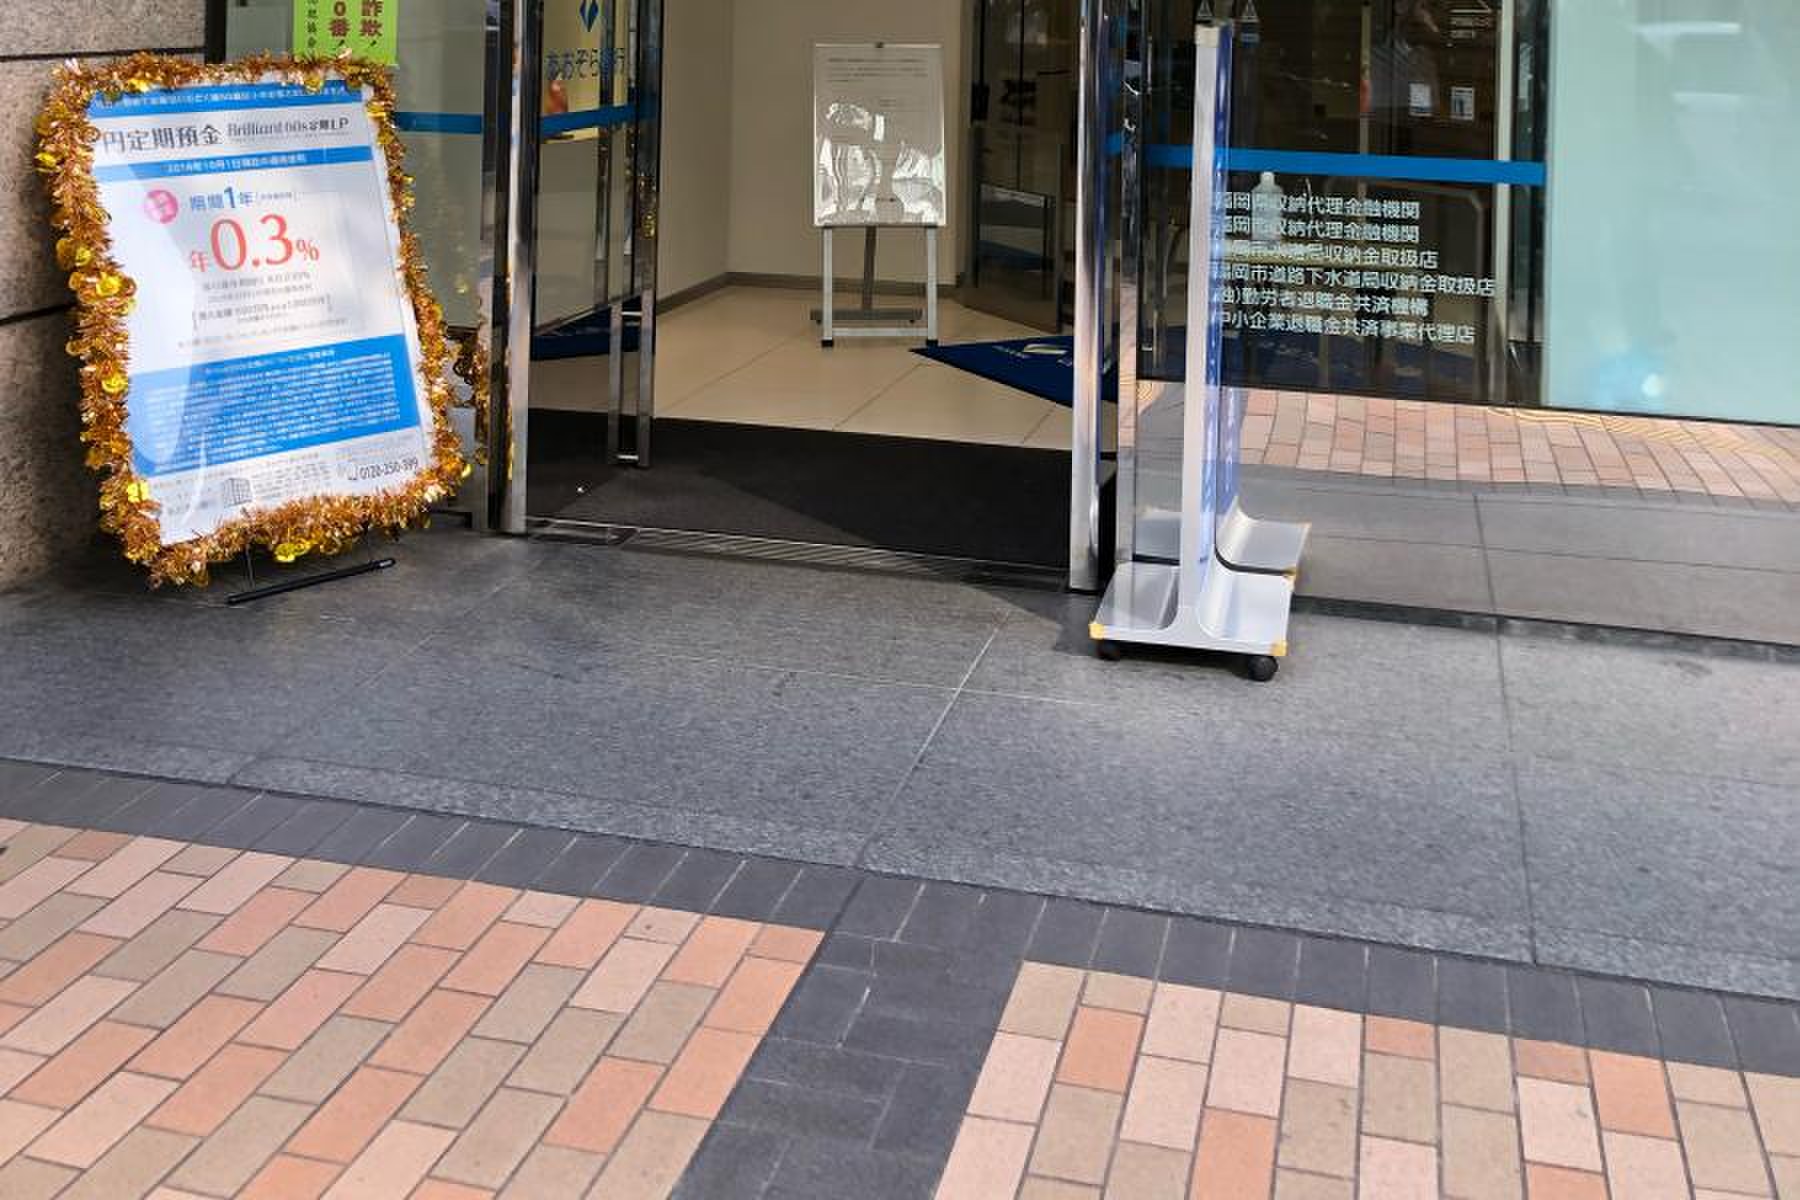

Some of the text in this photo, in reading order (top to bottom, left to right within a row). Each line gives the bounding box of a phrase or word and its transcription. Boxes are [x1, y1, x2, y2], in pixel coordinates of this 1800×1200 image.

[101, 123, 222, 154] 円定期預金
